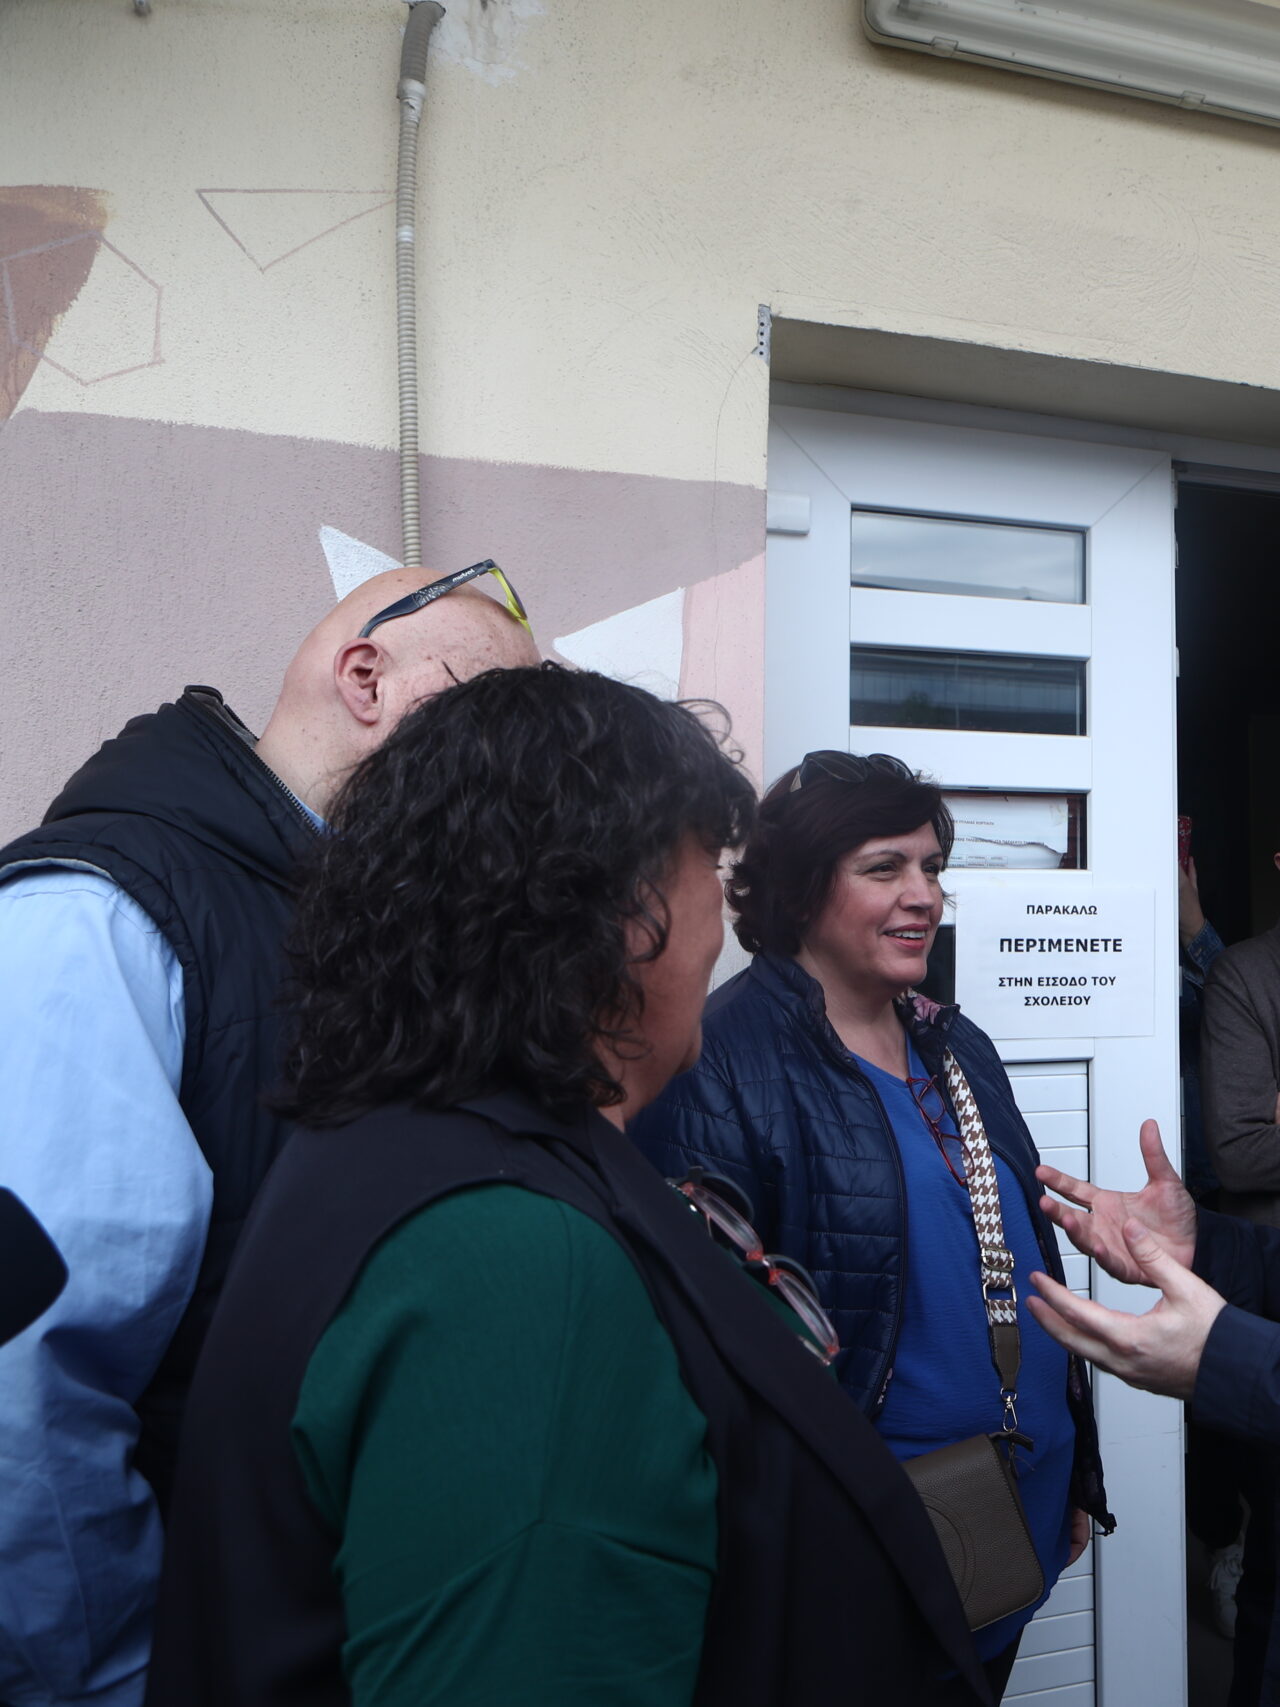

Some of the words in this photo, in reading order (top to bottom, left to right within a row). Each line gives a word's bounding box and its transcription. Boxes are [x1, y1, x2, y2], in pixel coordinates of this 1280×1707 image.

[1026, 904, 1098, 915] ΠΑΡΑΚΑΛΩ
[1000, 938, 1123, 953] ΠΕΡΙΜΕΝΕΤΕ
[998, 977, 1033, 987] ΣΤΗΝ
[1037, 976, 1087, 987] ΕΙΣΟΔΟ
[1091, 976, 1116, 986] ΤΟΥ
[1024, 996, 1091, 1006] ΣΧΟΛΕΙΟΥ
